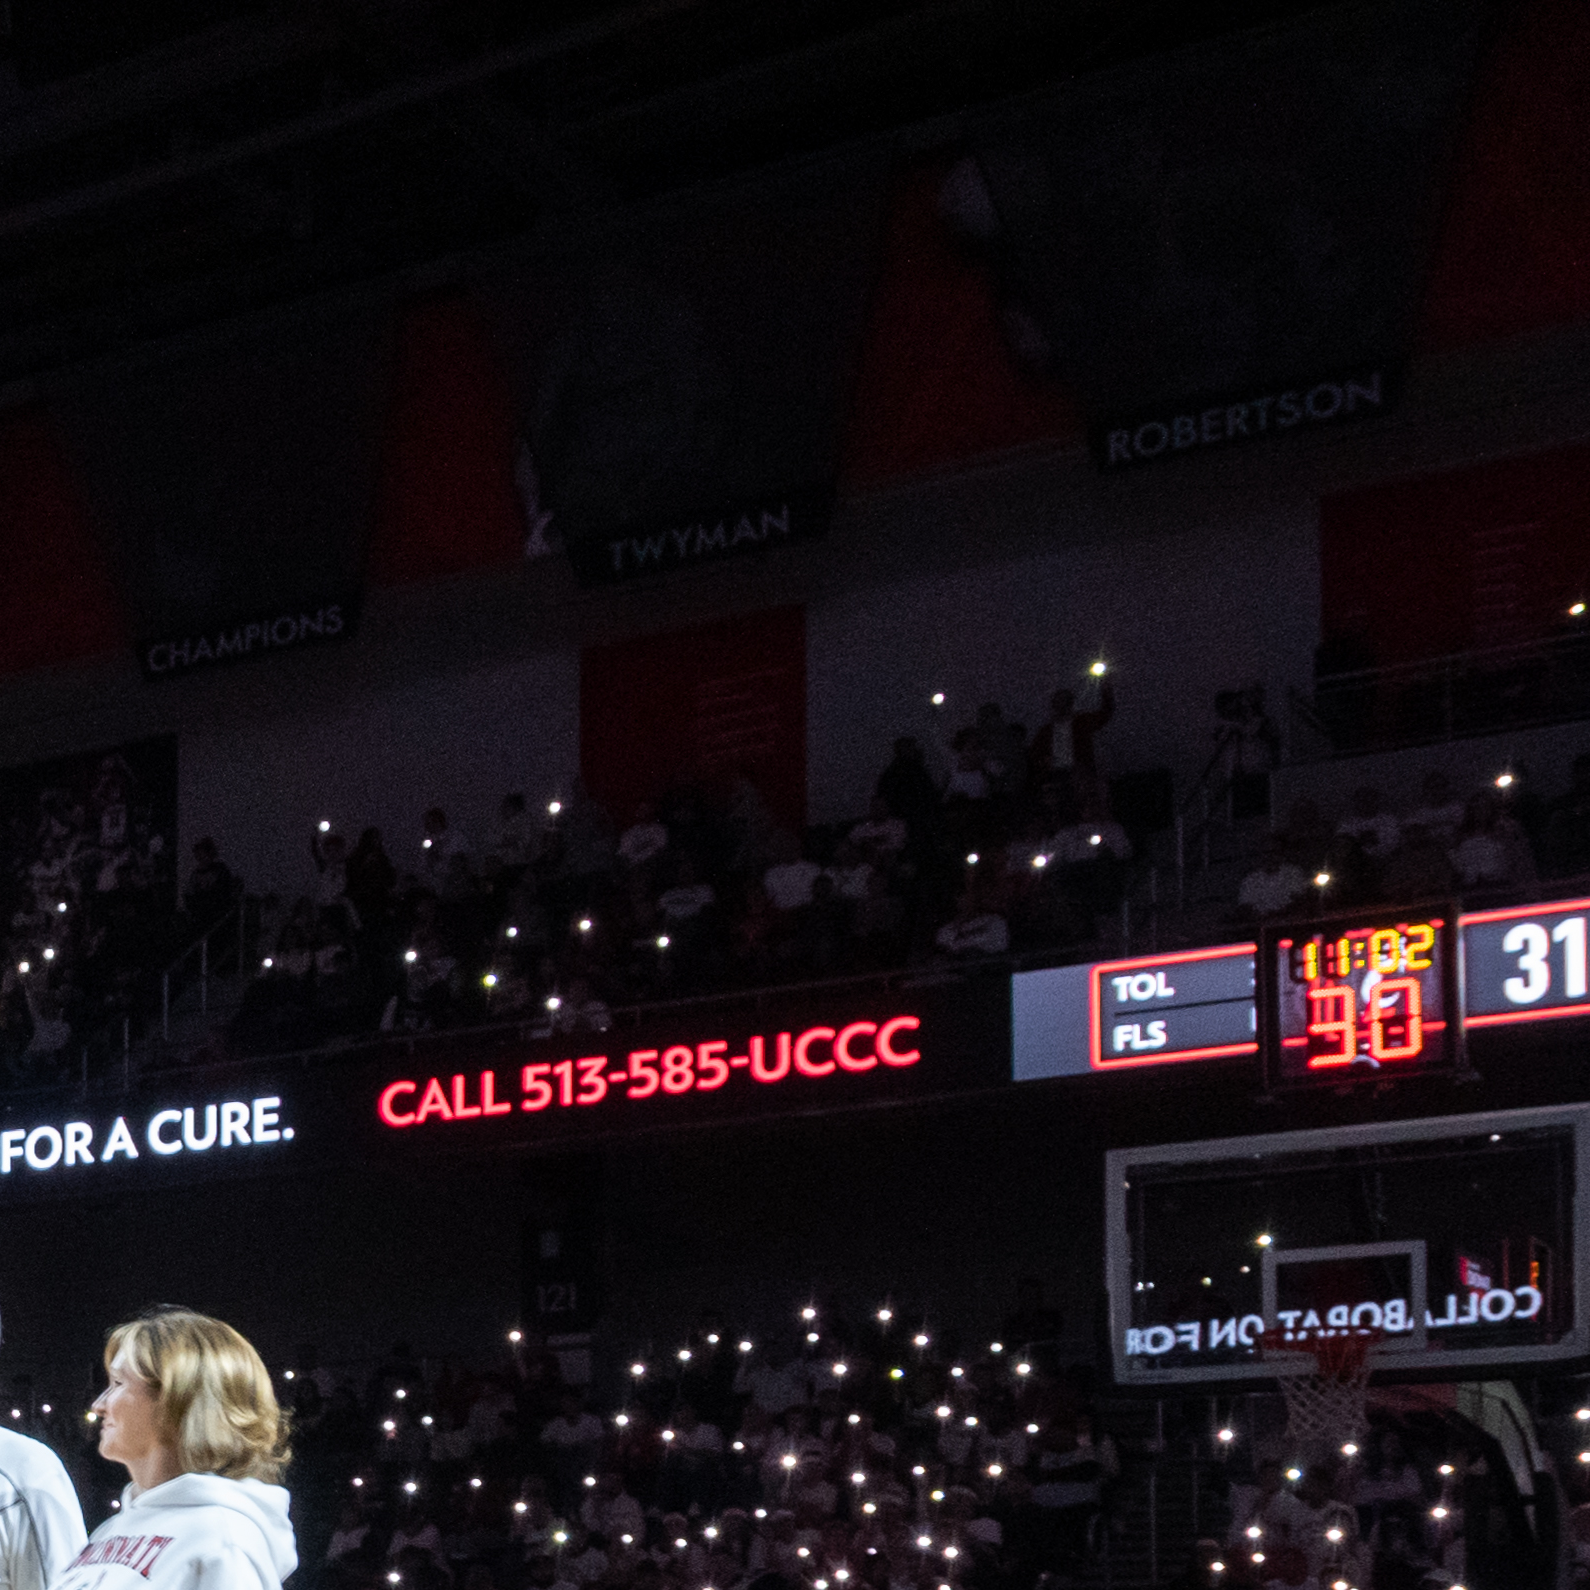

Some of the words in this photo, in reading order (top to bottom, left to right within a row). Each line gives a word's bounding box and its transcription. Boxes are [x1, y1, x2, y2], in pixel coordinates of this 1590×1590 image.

[1106, 372, 1383, 464] ROBERTSON
[607, 505, 790, 573] TWYMAN
[146, 605, 343, 673] CHAMPIONS
[1112, 971, 1176, 1002] TOL
[1113, 1020, 1168, 1052] FLS
[378, 1070, 512, 1128] CALL
[521, 1015, 921, 1112] 513-585-UCCC
[0, 1121, 95, 1175] FOR
[101, 1116, 140, 1163] A
[146, 1096, 295, 1156] CURE.
[537, 1282, 578, 1313] 121
